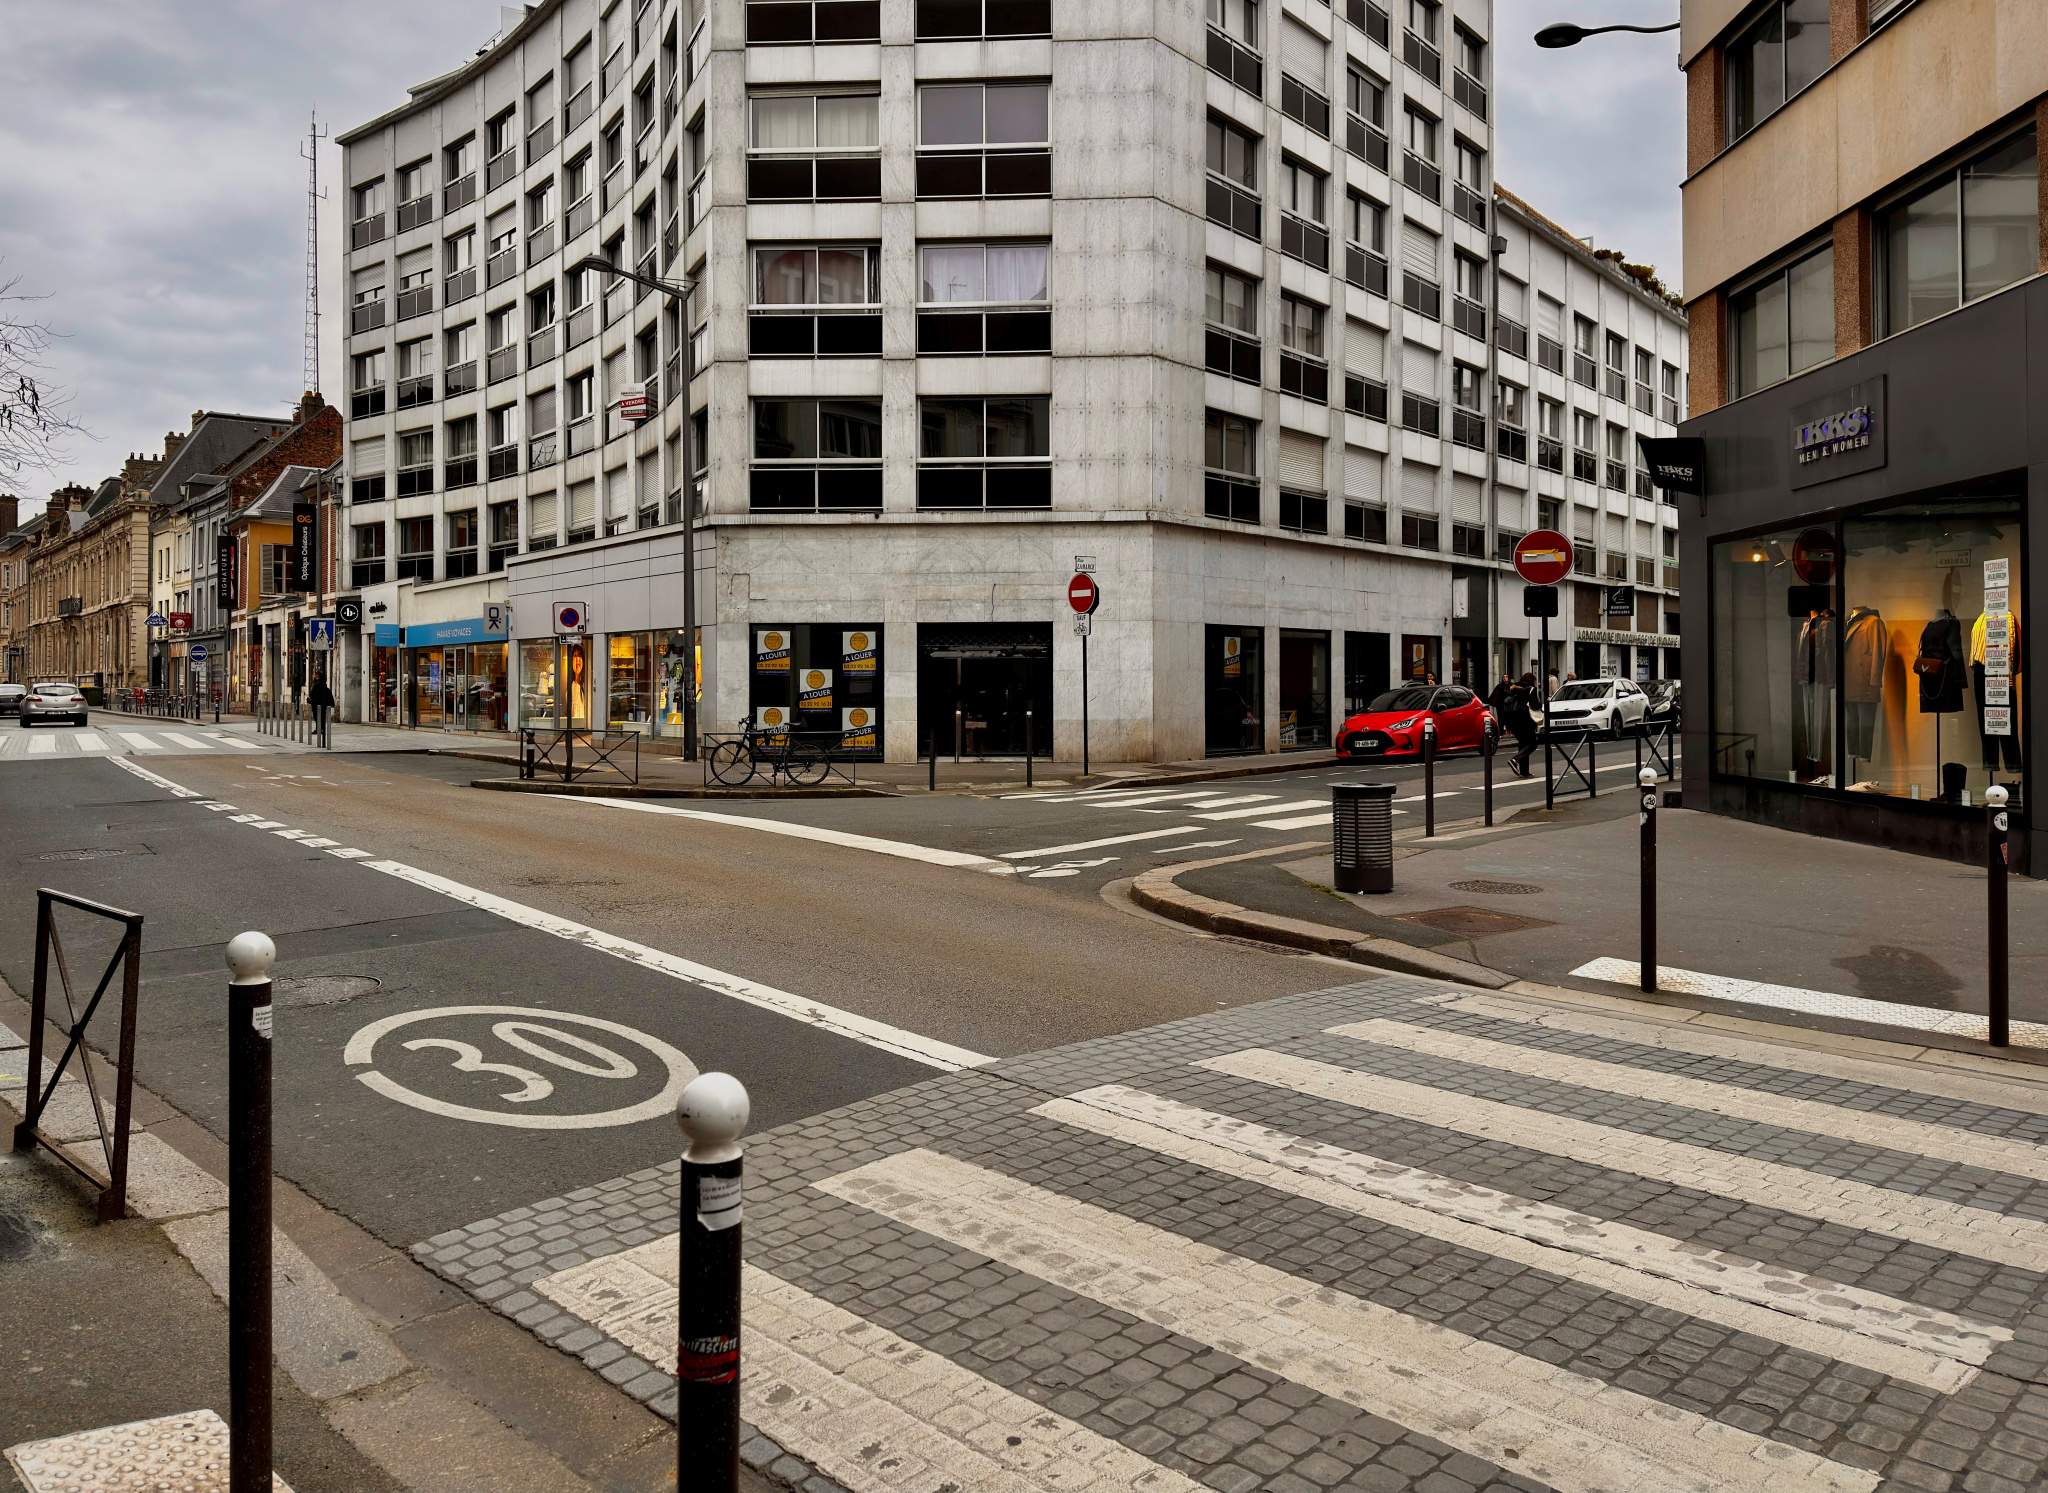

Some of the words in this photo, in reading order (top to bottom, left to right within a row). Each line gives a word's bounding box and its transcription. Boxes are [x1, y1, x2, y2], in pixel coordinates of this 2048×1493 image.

[1794, 409, 1864, 450] IKKS
[1799, 450, 1818, 464] MEN
[1822, 446, 1830, 456] &
[1832, 436, 1868, 454] WOMEN
[301, 556, 309, 580] Optique
[1985, 561, 2006, 571] DESTOCKAGE
[436, 630, 450, 638] HAVAS
[451, 628, 471, 637] VOYAGES
[765, 651, 787, 660] LOUER
[851, 652, 872, 660] LOUER
[810, 690, 831, 698] LOUER
[402, 1021, 638, 1103] 30
